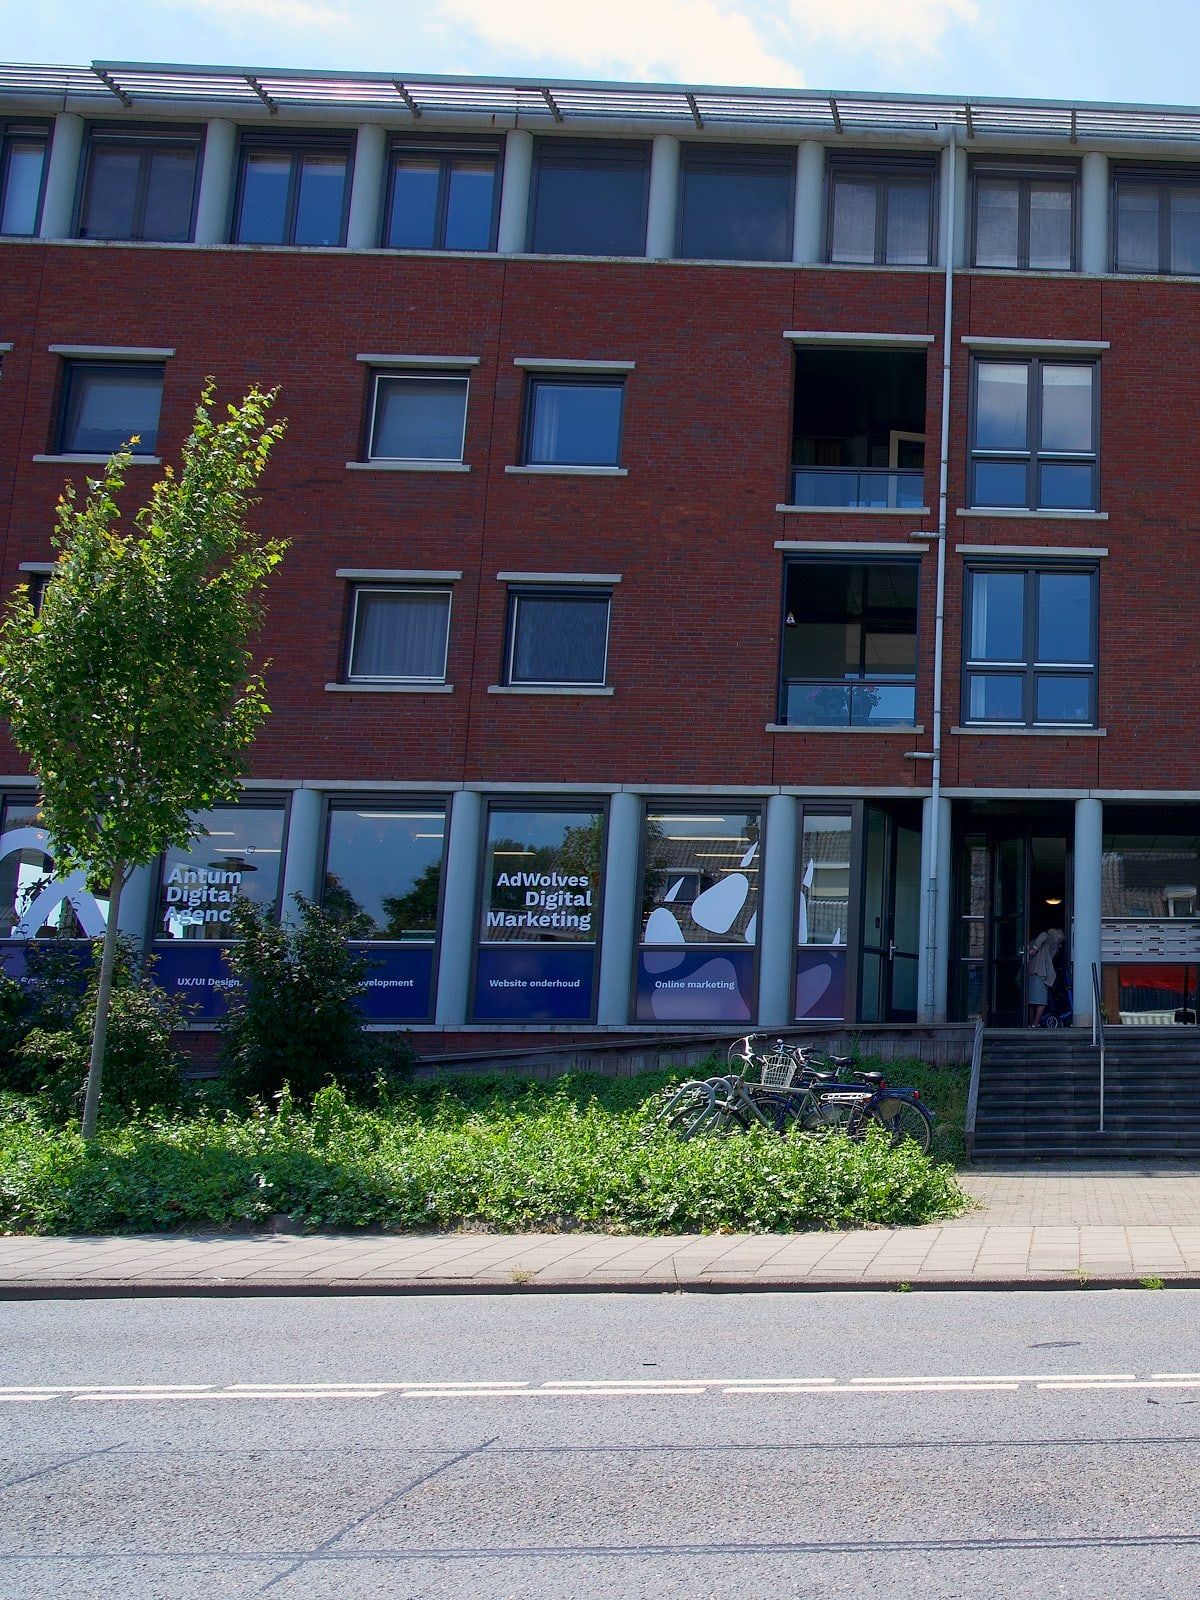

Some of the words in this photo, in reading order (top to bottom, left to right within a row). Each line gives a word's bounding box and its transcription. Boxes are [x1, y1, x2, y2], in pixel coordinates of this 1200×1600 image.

[167, 868, 242, 884] Antum
[497, 872, 589, 887] AdWolves
[166, 886, 238, 906] Digital
[525, 890, 592, 910] Digital
[163, 906, 241, 926] Agenc
[486, 910, 592, 931] Marketing
[177, 977, 206, 987] UX/UI
[207, 977, 240, 988] Design
[489, 979, 527, 988] Website
[529, 979, 581, 988] onderhoud
[654, 980, 686, 989] Online
[687, 980, 735, 992] marketing
